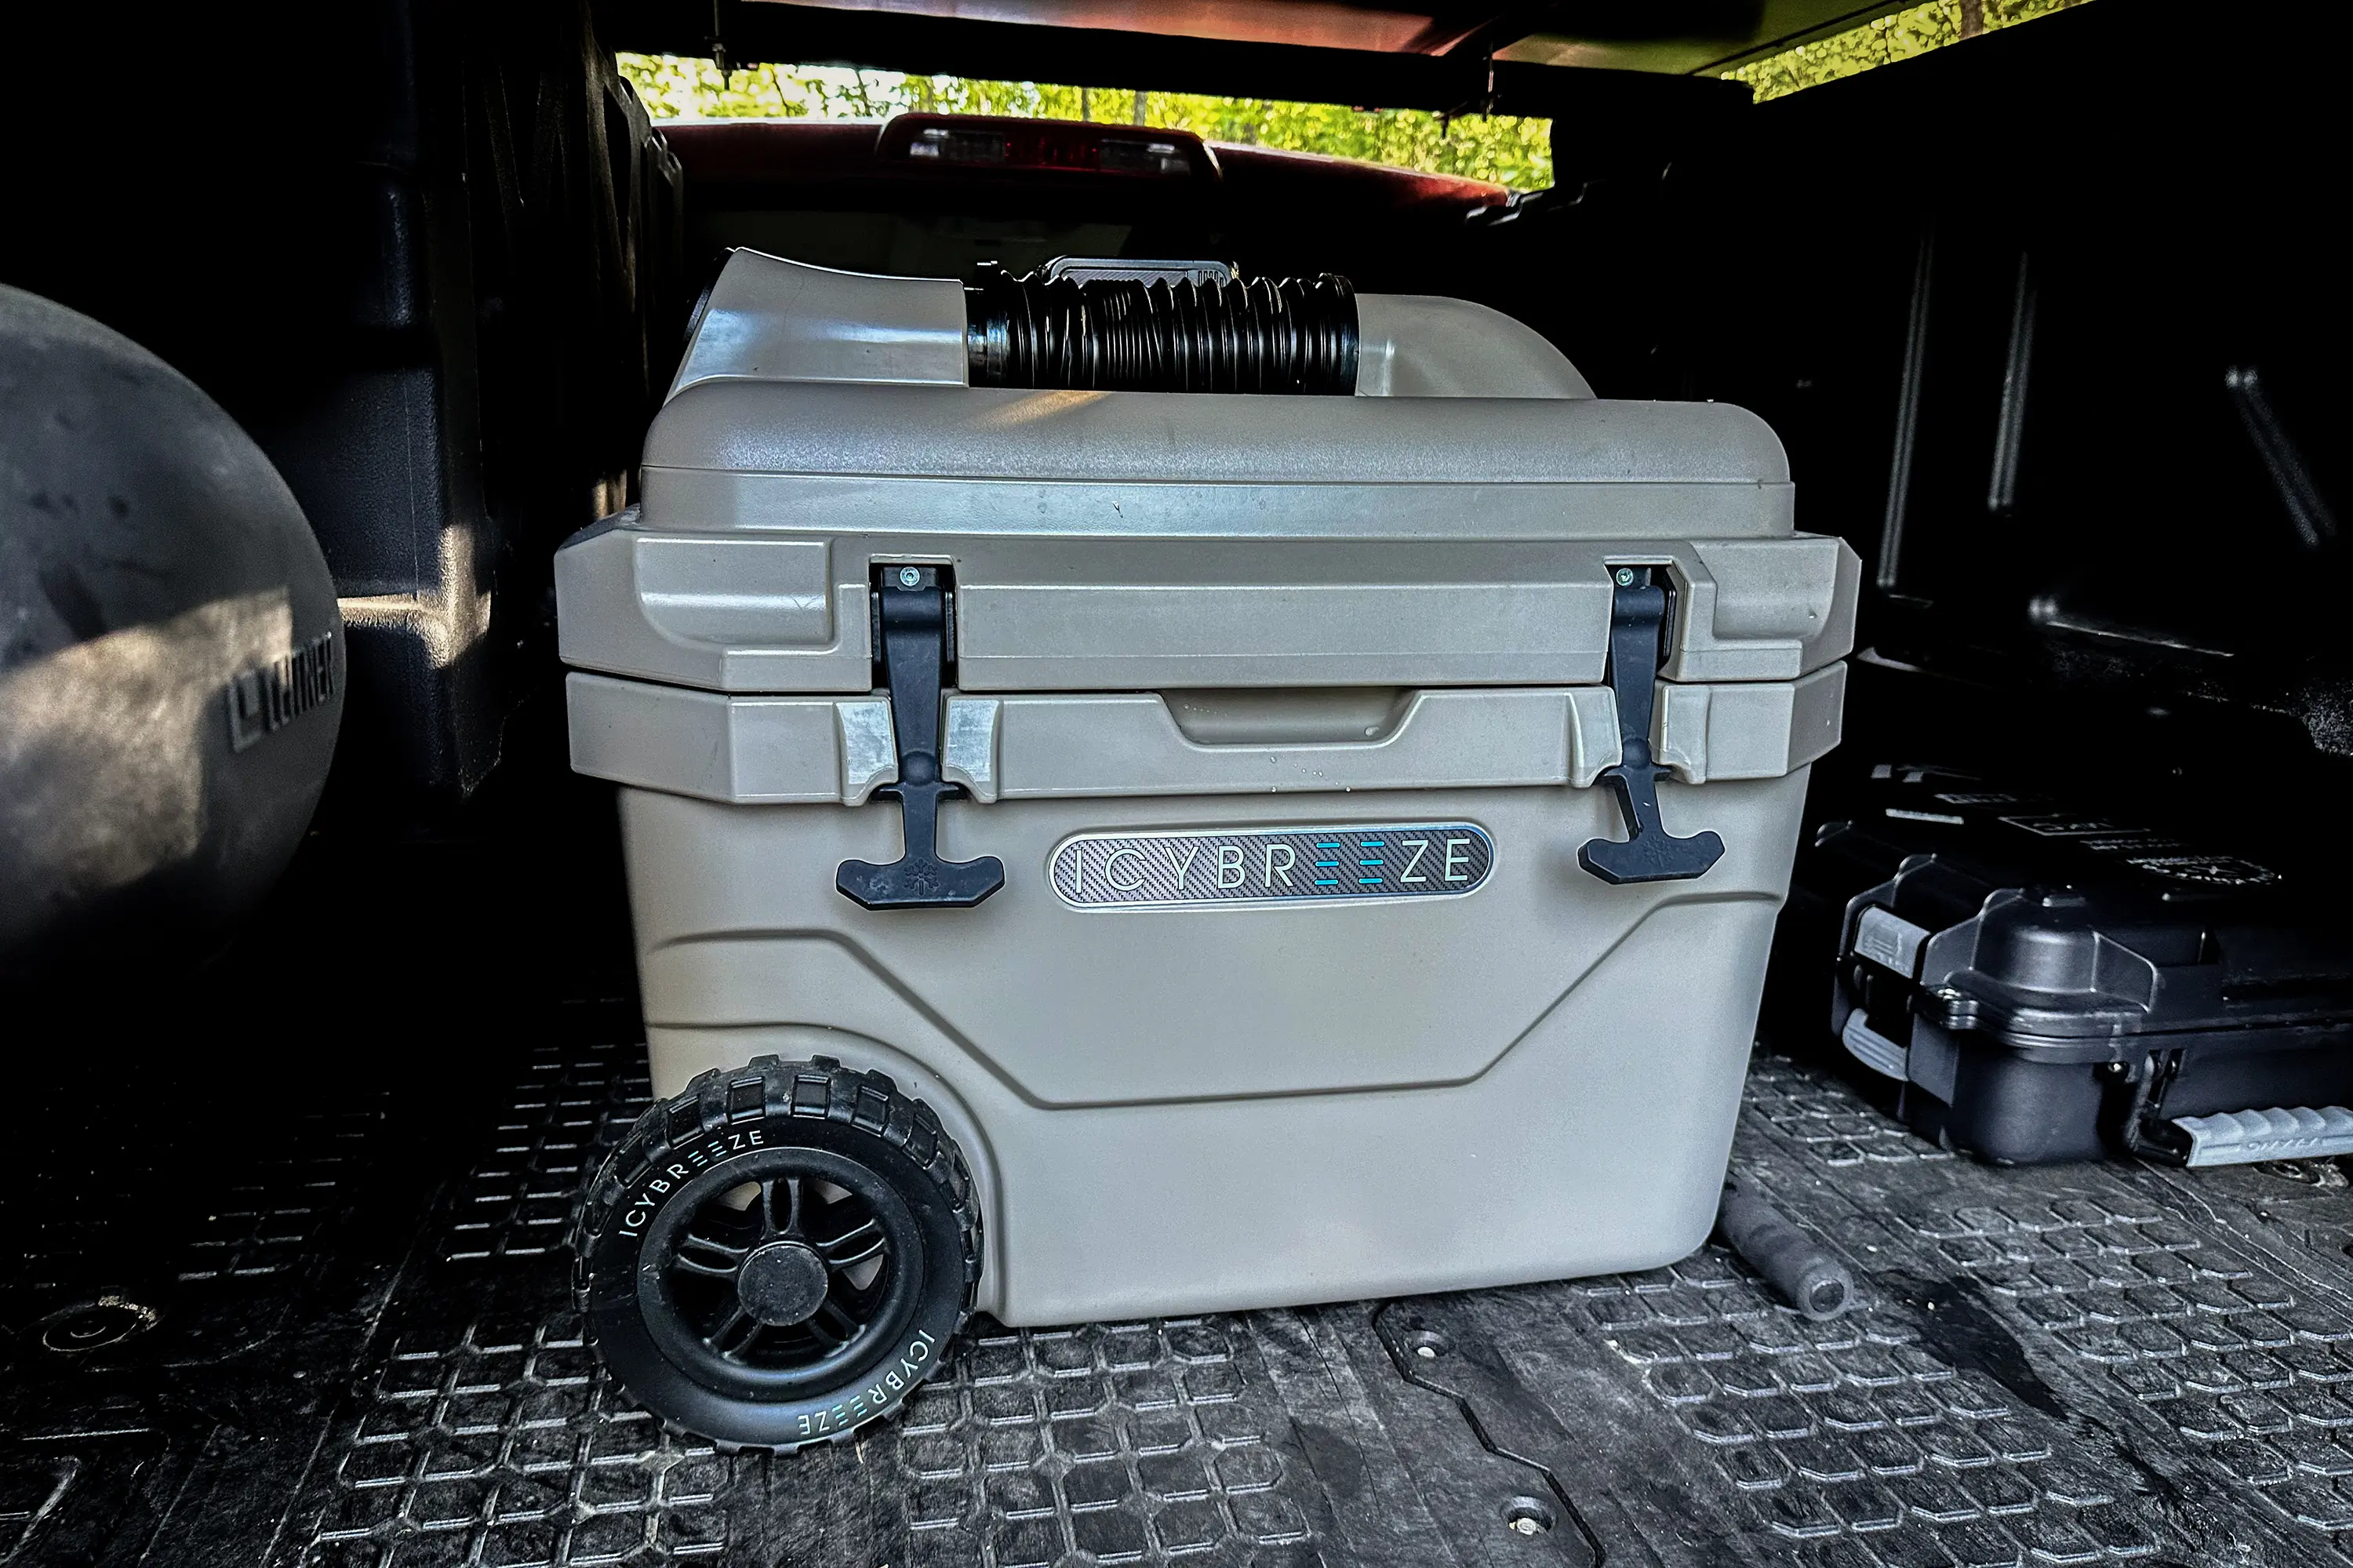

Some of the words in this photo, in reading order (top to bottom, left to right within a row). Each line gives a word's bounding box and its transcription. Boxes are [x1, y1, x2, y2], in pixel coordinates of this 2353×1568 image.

[1075, 837, 1471, 894] ICYBREEZE
[618, 1130, 765, 1237] ICYBREEZE
[797, 1329, 936, 1435] ICYBREEZE
